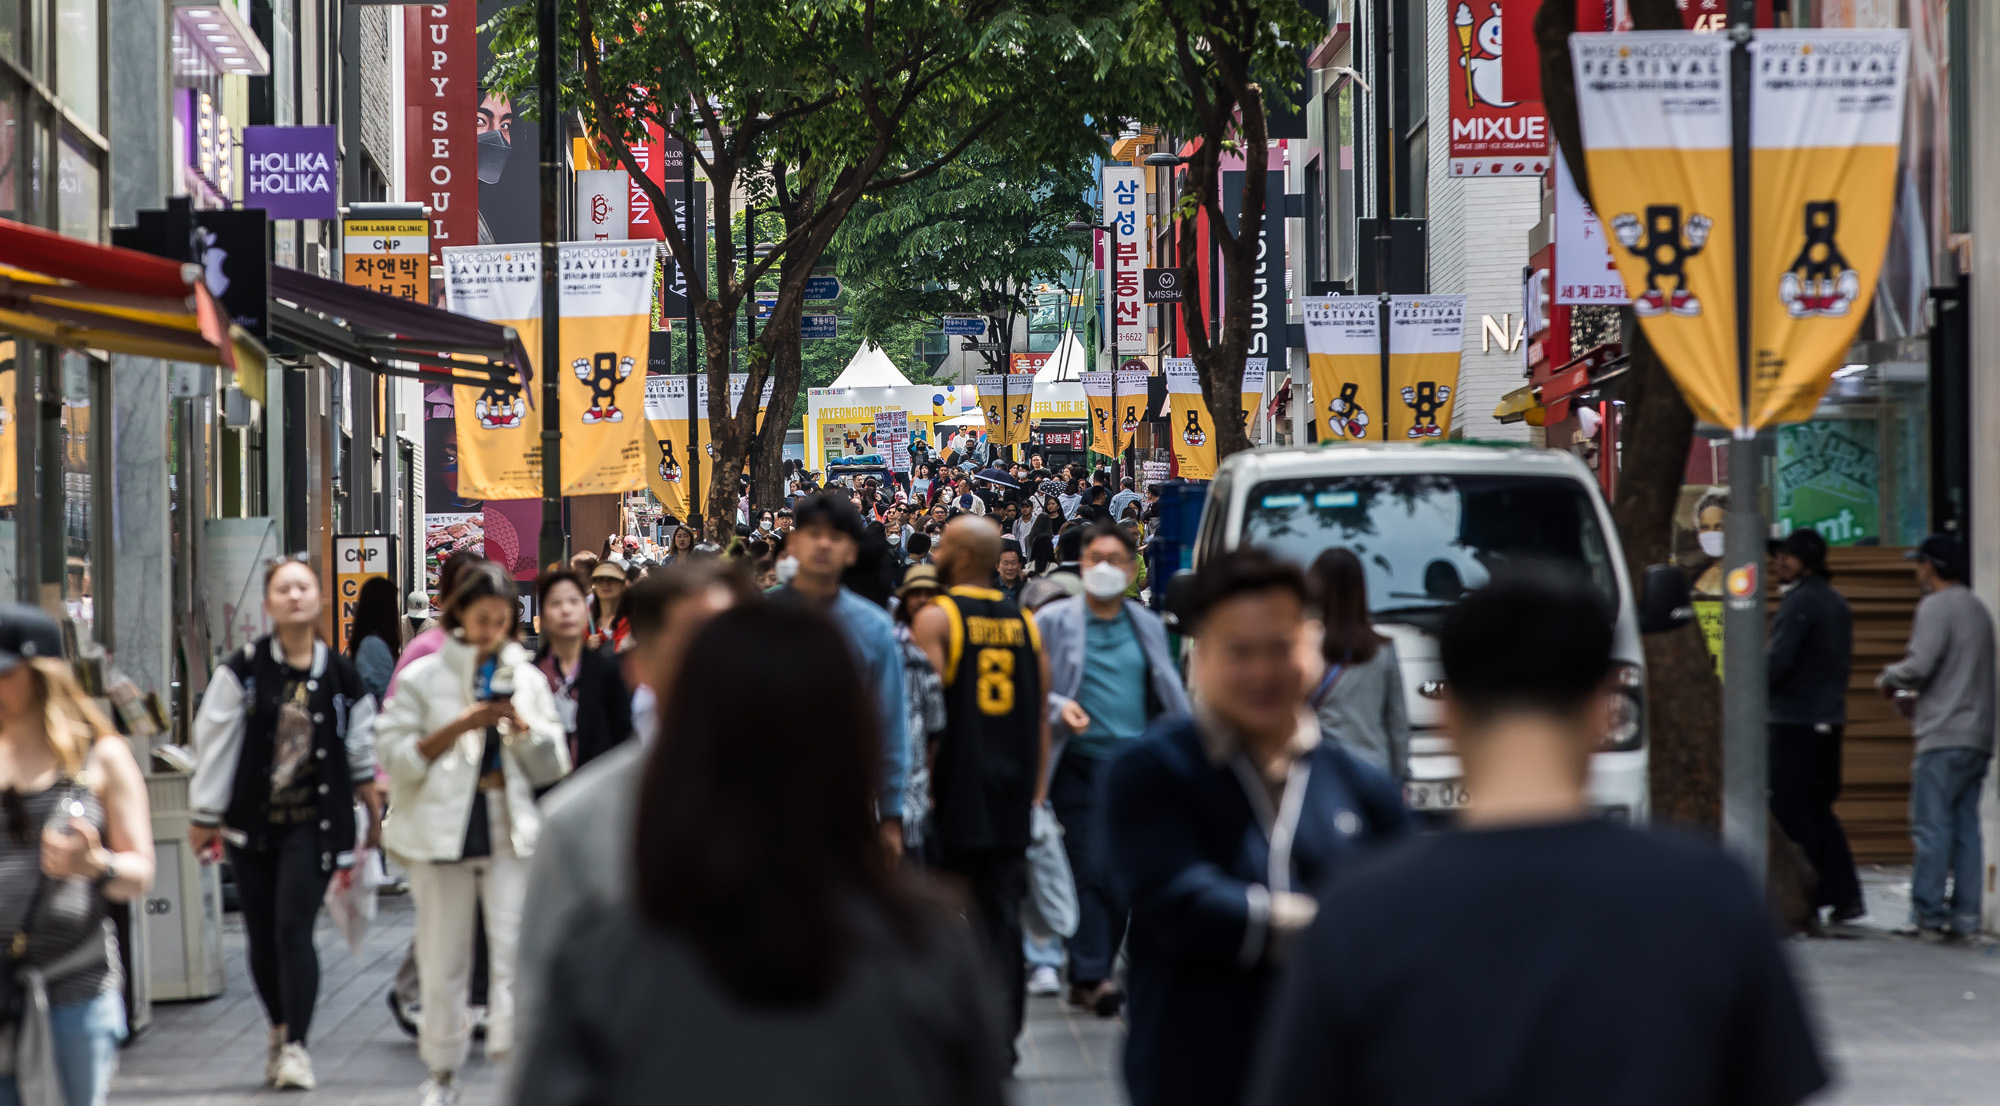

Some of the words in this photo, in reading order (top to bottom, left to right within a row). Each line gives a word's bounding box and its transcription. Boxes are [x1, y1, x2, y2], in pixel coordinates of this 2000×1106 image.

[1693, 14, 1727, 34] 4F
[1584, 59, 1719, 75] FESTIVAL
[1762, 58, 1897, 74] FESTIVAL
[1453, 116, 1545, 140] MIXUE
[249, 153, 330, 173] HOLIKA
[430, 111, 450, 239] SEOUL
[249, 174, 330, 194] HOLIKA
[373, 240, 400, 250] CNP
[355, 258, 419, 280] 차앤박
[1561, 284, 1630, 299] 세계과자
[1306, 302, 1374, 310] MYEONGDONG
[1394, 300, 1464, 308] MYEONGDONG
[1306, 310, 1375, 318] FESTIVAL
[1394, 308, 1462, 317] FESTIVAL
[819, 406, 882, 419] MYEONGDONG
[1056, 401, 1072, 412] THE
[1046, 434, 1070, 444] 상품권
[345, 548, 378, 562] CNP
[977, 648, 1016, 716] 8
